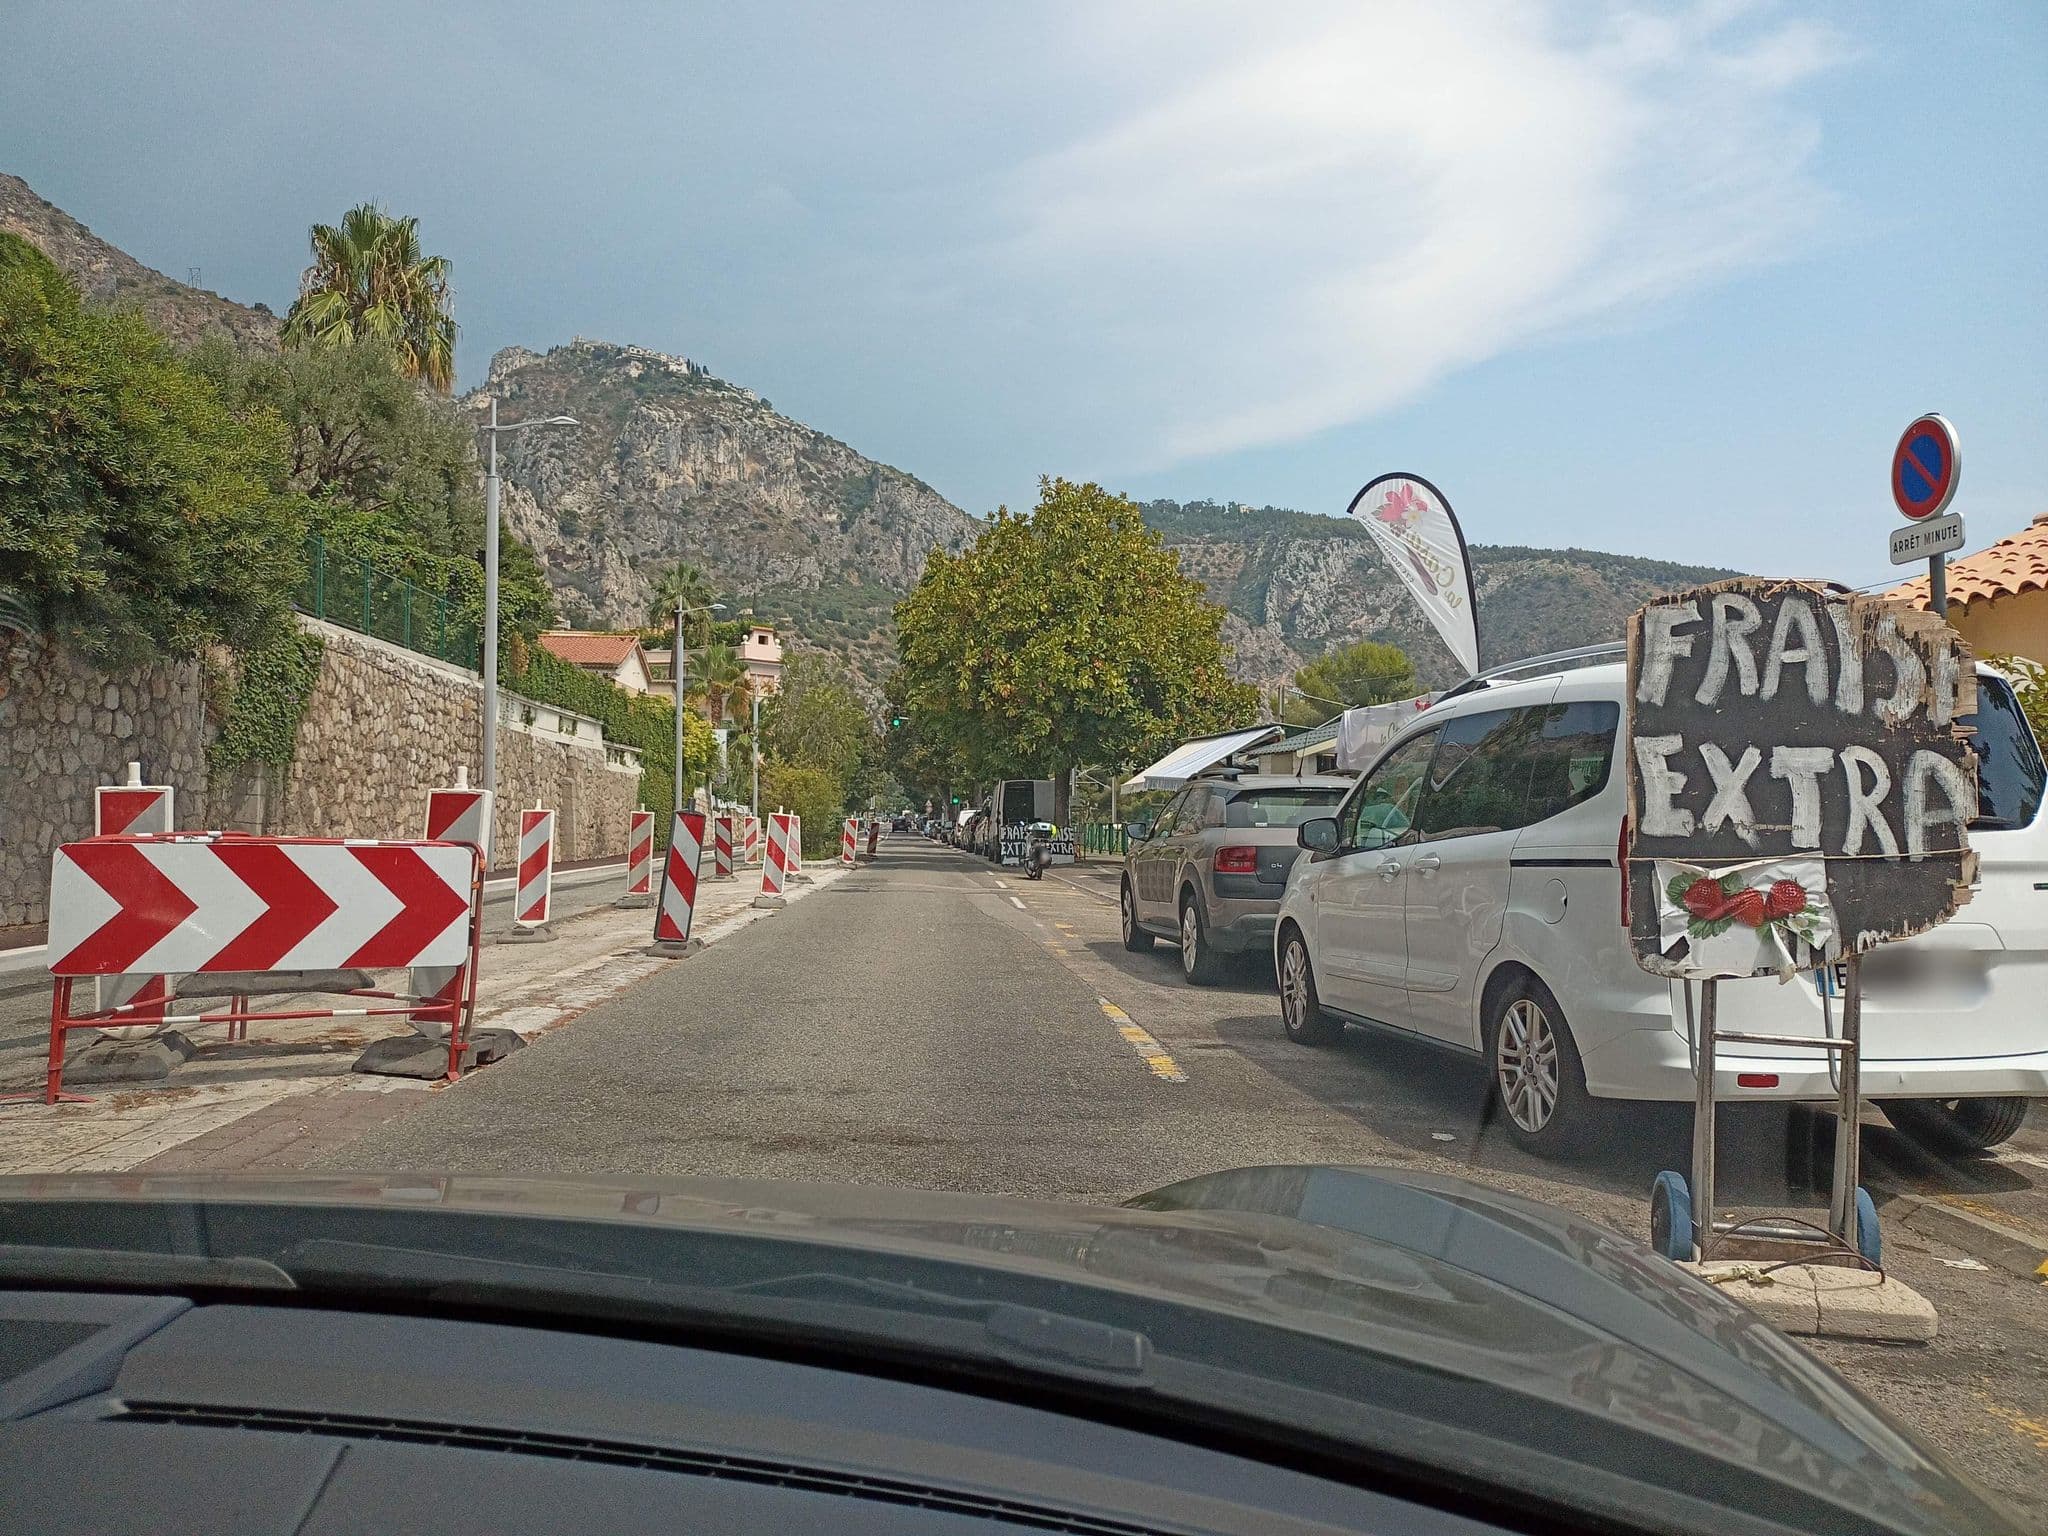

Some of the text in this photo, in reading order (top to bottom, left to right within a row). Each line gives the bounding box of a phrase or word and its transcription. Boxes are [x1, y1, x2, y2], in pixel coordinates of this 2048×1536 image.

[1893, 525, 1957, 554] ARRÊT MINUTE
[1634, 734, 1977, 862] EXTRA
[1048, 842, 1074, 854] XTRA
